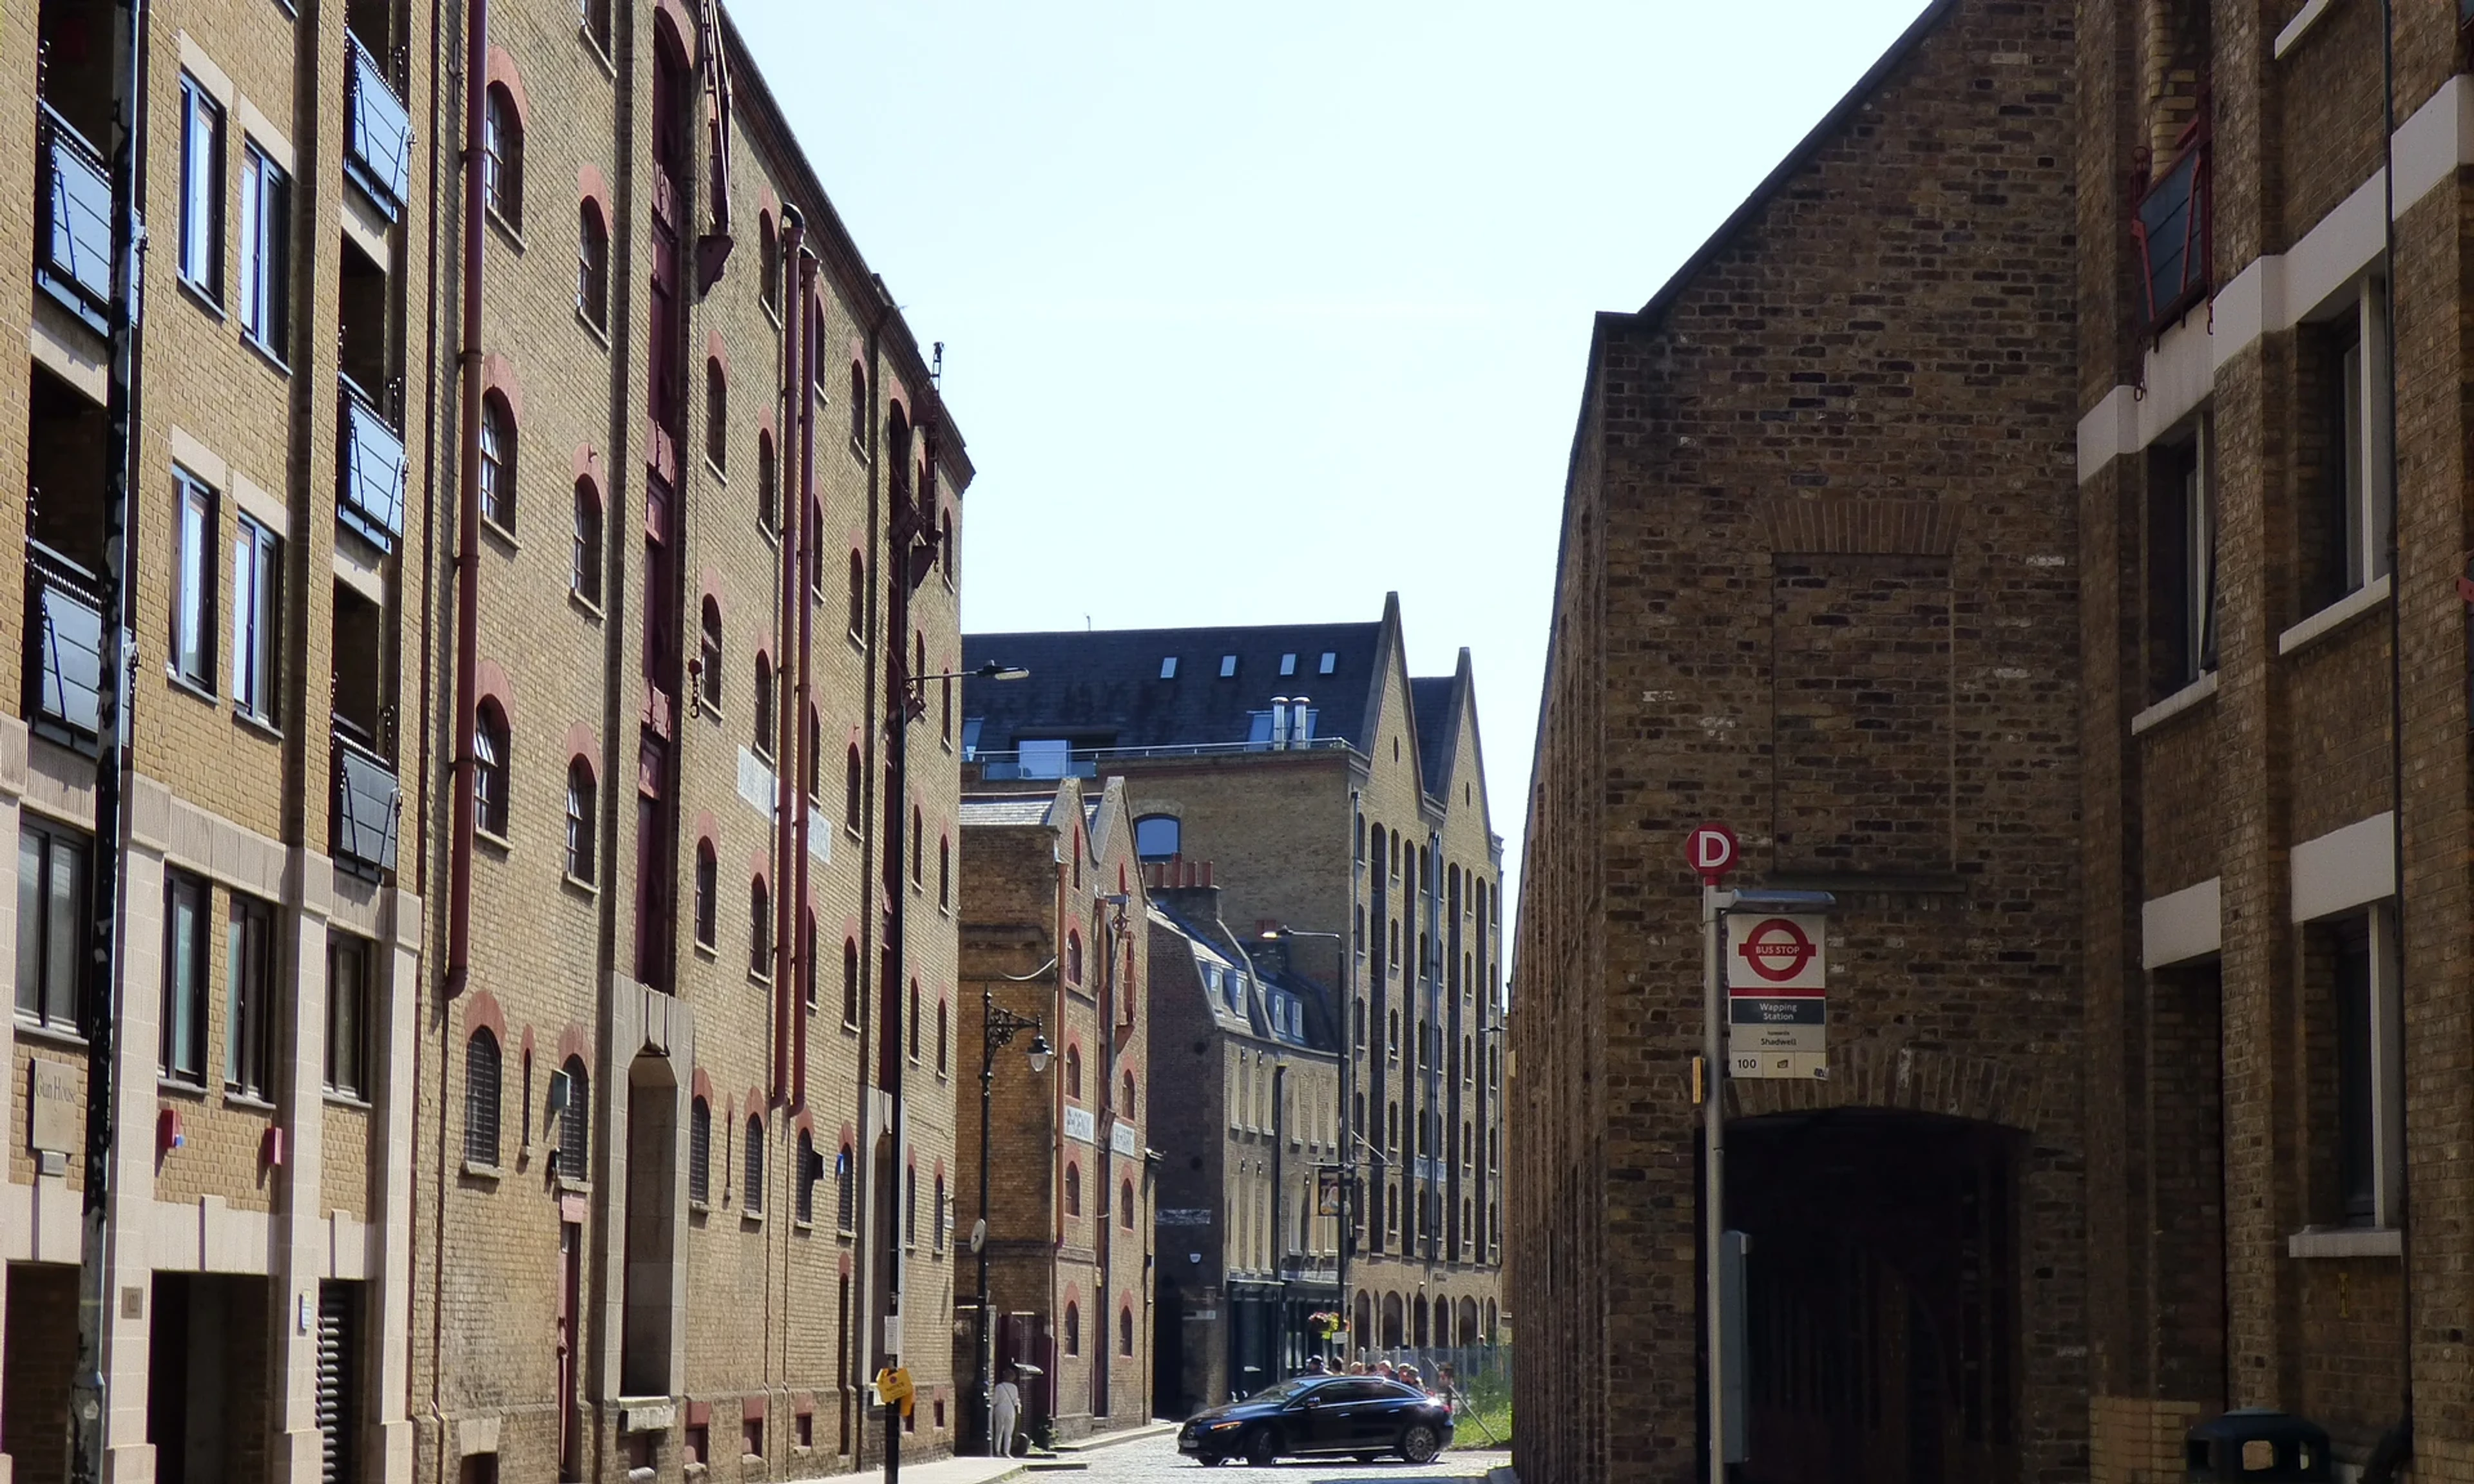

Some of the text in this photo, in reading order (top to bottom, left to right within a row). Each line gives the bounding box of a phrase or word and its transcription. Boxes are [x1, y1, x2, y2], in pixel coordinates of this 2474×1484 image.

[1699, 831, 1731, 867] D
[1756, 946, 1799, 954] BUS STOP
[1760, 1003, 1797, 1013] Wapping
[1738, 1059, 1756, 1069] 100
[36, 1072, 52, 1099] Gun
